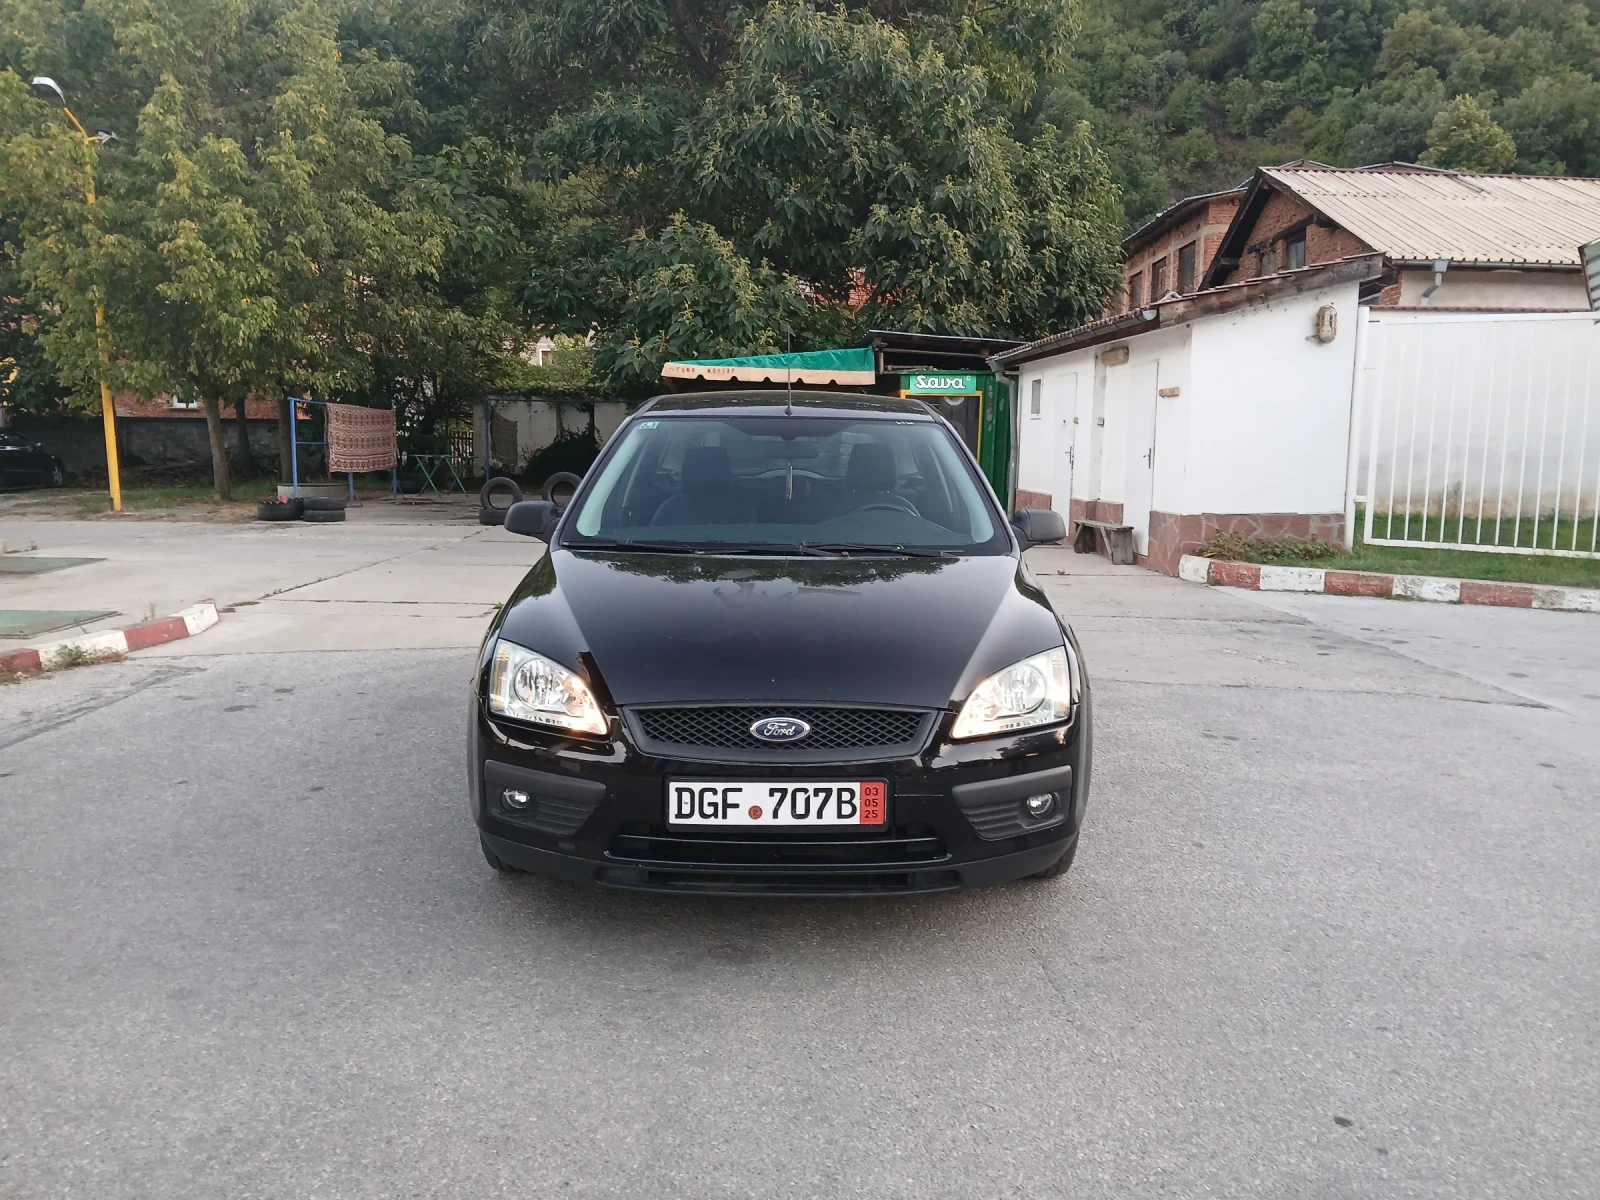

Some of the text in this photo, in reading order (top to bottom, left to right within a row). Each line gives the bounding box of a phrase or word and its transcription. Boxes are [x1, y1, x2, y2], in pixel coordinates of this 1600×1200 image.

[915, 374, 966, 389] Sava
[763, 722, 796, 736] Ford
[864, 786, 879, 796] 03
[674, 786, 858, 820] DGF 707B
[864, 798, 879, 807] 05
[864, 809, 878, 819] 25
